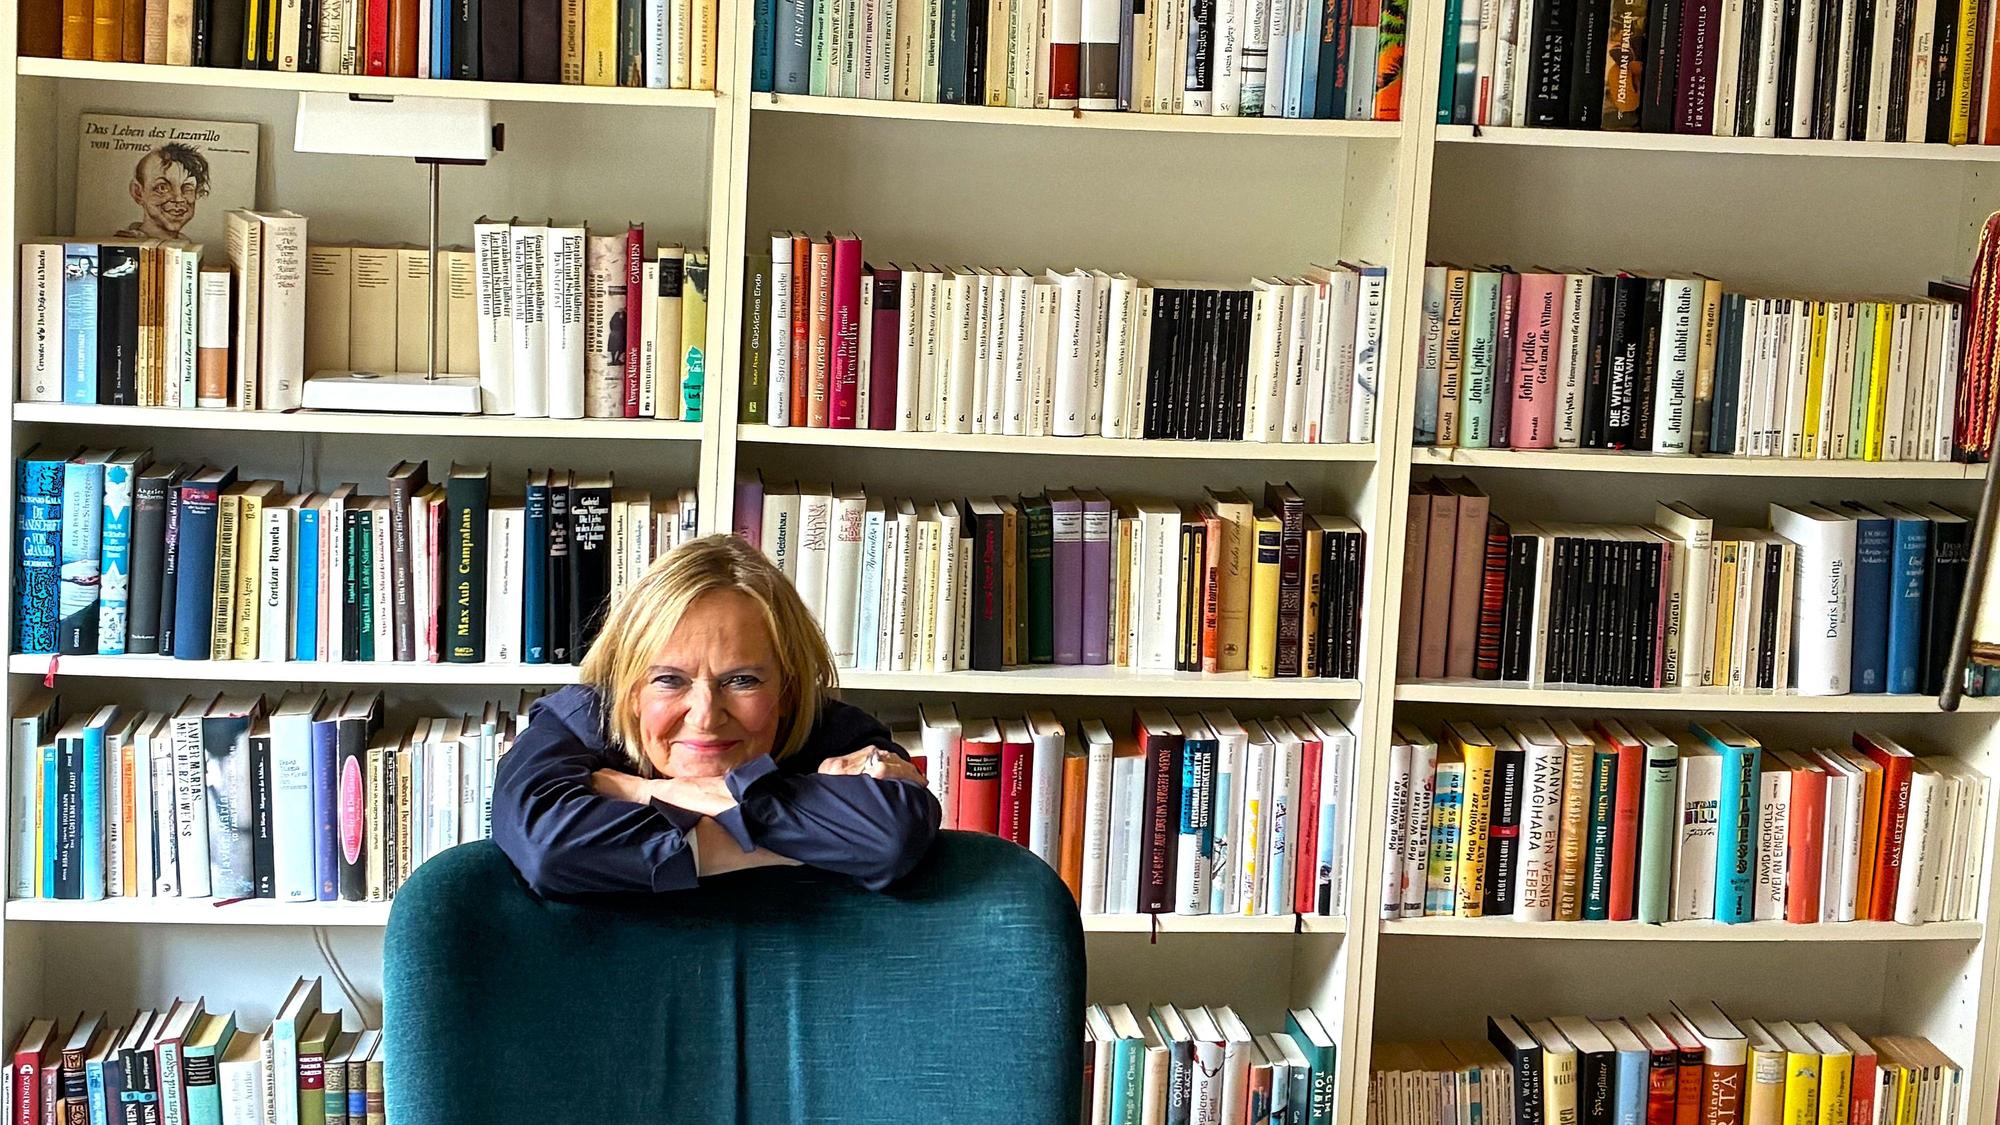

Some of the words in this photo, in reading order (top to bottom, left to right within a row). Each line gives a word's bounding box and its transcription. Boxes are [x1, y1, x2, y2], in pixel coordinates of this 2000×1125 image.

[1694, 6, 1708, 65] UNSCHULD
[1538, 34, 1551, 99] Jonathan
[1550, 34, 1563, 100] FRANZEN
[1694, 75, 1707, 127] FRANZEN
[85, 122, 108, 137] Das
[112, 124, 144, 138] Leben
[148, 126, 166, 139] des
[169, 126, 220, 142] Lazarillo
[90, 140, 110, 151] von
[113, 139, 152, 152] Tormes
[631, 243, 640, 283] CARMEN
[753, 273, 762, 297] Ende
[777, 273, 787, 297] Liebe
[777, 299, 787, 319] Eine
[1540, 292, 1552, 327] Wilmots
[1677, 287, 1691, 314] Ruhe
[1539, 329, 1550, 343] die
[1674, 316, 1688, 326] in
[777, 329, 786, 356] Mesa
[1444, 330, 1461, 370] Updike
[1471, 338, 1487, 375] Updike
[1521, 332, 1537, 371] Updike
[1539, 345, 1549, 361] und
[1673, 329, 1688, 362] Rabbit
[776, 359, 785, 383] Sara
[1537, 363, 1548, 384] Gott
[1611, 356, 1625, 407] WITWEN
[1623, 343, 1636, 403] EASTWICK
[1442, 373, 1458, 400] John
[1470, 378, 1484, 404] John
[1518, 374, 1533, 402] John
[1669, 369, 1687, 406] Updike
[1609, 410, 1620, 427] DIE
[1621, 405, 1631, 427] VON
[1668, 408, 1683, 434] John
[24, 537, 55, 557] GRANADA
[32, 531, 46, 544] VON
[269, 526, 281, 562] Rayuela
[458, 508, 474, 574] Campalans
[777, 512, 787, 557] Geisterhaus
[777, 558, 785, 572] as
[268, 567, 279, 607] Cortázar
[458, 582, 469, 606] Aub
[1828, 560, 1842, 603] Lessing
[458, 610, 469, 636] Max
[1668, 592, 1680, 636] Dracula
[1826, 607, 1839, 638] Doris
[1307, 632, 1316, 670] ORWELL
[1480, 769, 1492, 808] LEBEN
[1548, 756, 1563, 806] HANYA
[1898, 781, 1909, 809] WORT
[1390, 781, 1401, 825] Wolitzer
[1410, 792, 1422, 835] Wolitzer
[1419, 782, 1431, 845] STELLUNG
[1445, 774, 1460, 861] INTERESSANTEN
[1467, 793, 1479, 835] Wolitzer
[1528, 755, 1548, 850] YANAGIHARA
[1775, 803, 1786, 823] TAG
[1478, 813, 1488, 840] DEIN
[1595, 825, 1607, 843] Die
[1762, 803, 1774, 852] NICHOLLS
[1774, 825, 1785, 857] EINEM
[1893, 812, 1905, 844] LETZTE
[1545, 830, 1556, 854] EIN
[1891, 847, 1900, 866] DAS
[1418, 850, 1426, 870] DIE
[1498, 839, 1509, 876] BENJAMIN
[1760, 854, 1770, 884] DAVID
[1772, 860, 1782, 874] AN
[1443, 866, 1452, 883] DIE
[1524, 860, 1539, 908] LEBEN
[1590, 847, 1606, 901] Einladung
[1771, 877, 1781, 902] ZWEI
[162, 1050, 178, 1078] Sagen
[1521, 1056, 1531, 1096] Weldon
[164, 1080, 177, 1099] und
[1127, 1082, 1135, 1097] der
[1173, 1060, 1184, 1107] COUNTRY
[1522, 1102, 1532, 1119] Fay
